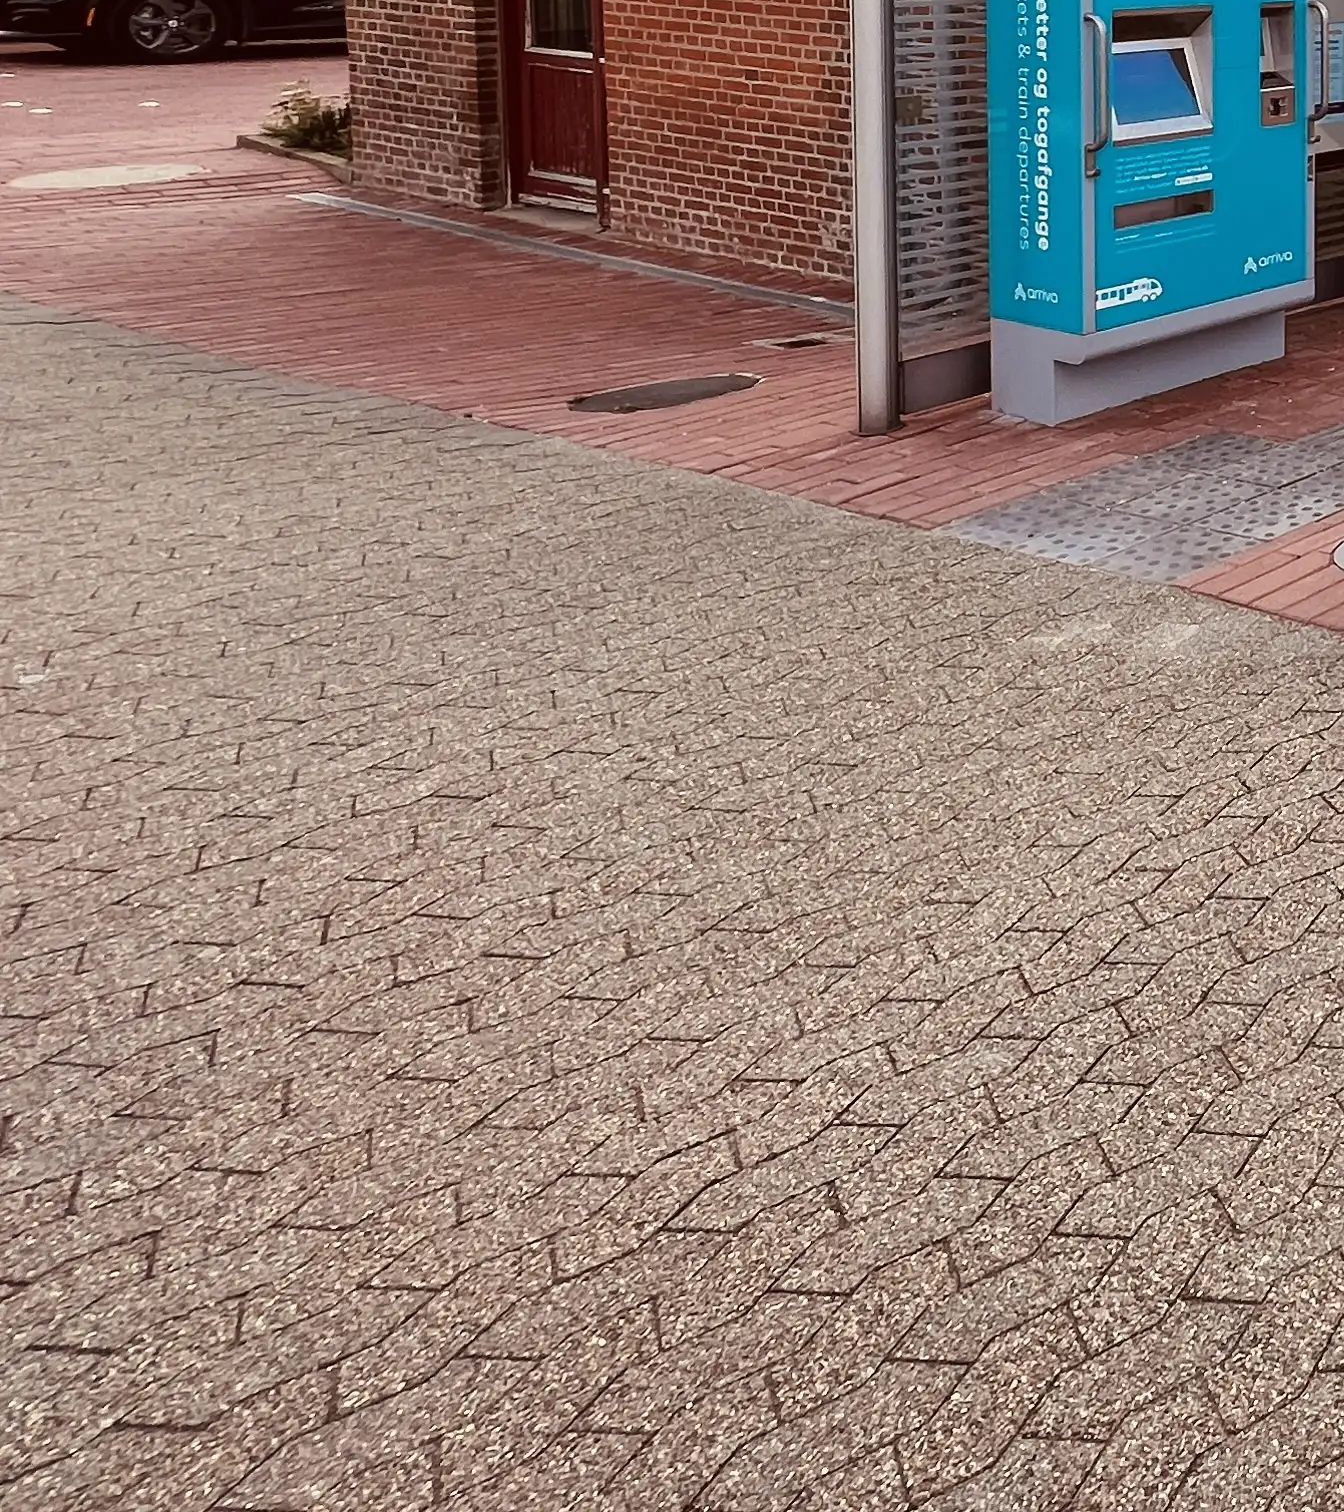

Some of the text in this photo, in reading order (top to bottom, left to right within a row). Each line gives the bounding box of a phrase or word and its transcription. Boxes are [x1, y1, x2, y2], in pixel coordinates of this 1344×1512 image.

[1017, 44, 1031, 58] &
[1017, 66, 1030, 119] train
[1033, 67, 1048, 99] og
[1017, 125, 1032, 251] departures
[1034, 105, 1052, 251] togafgange
[1258, 251, 1293, 267] arriva
